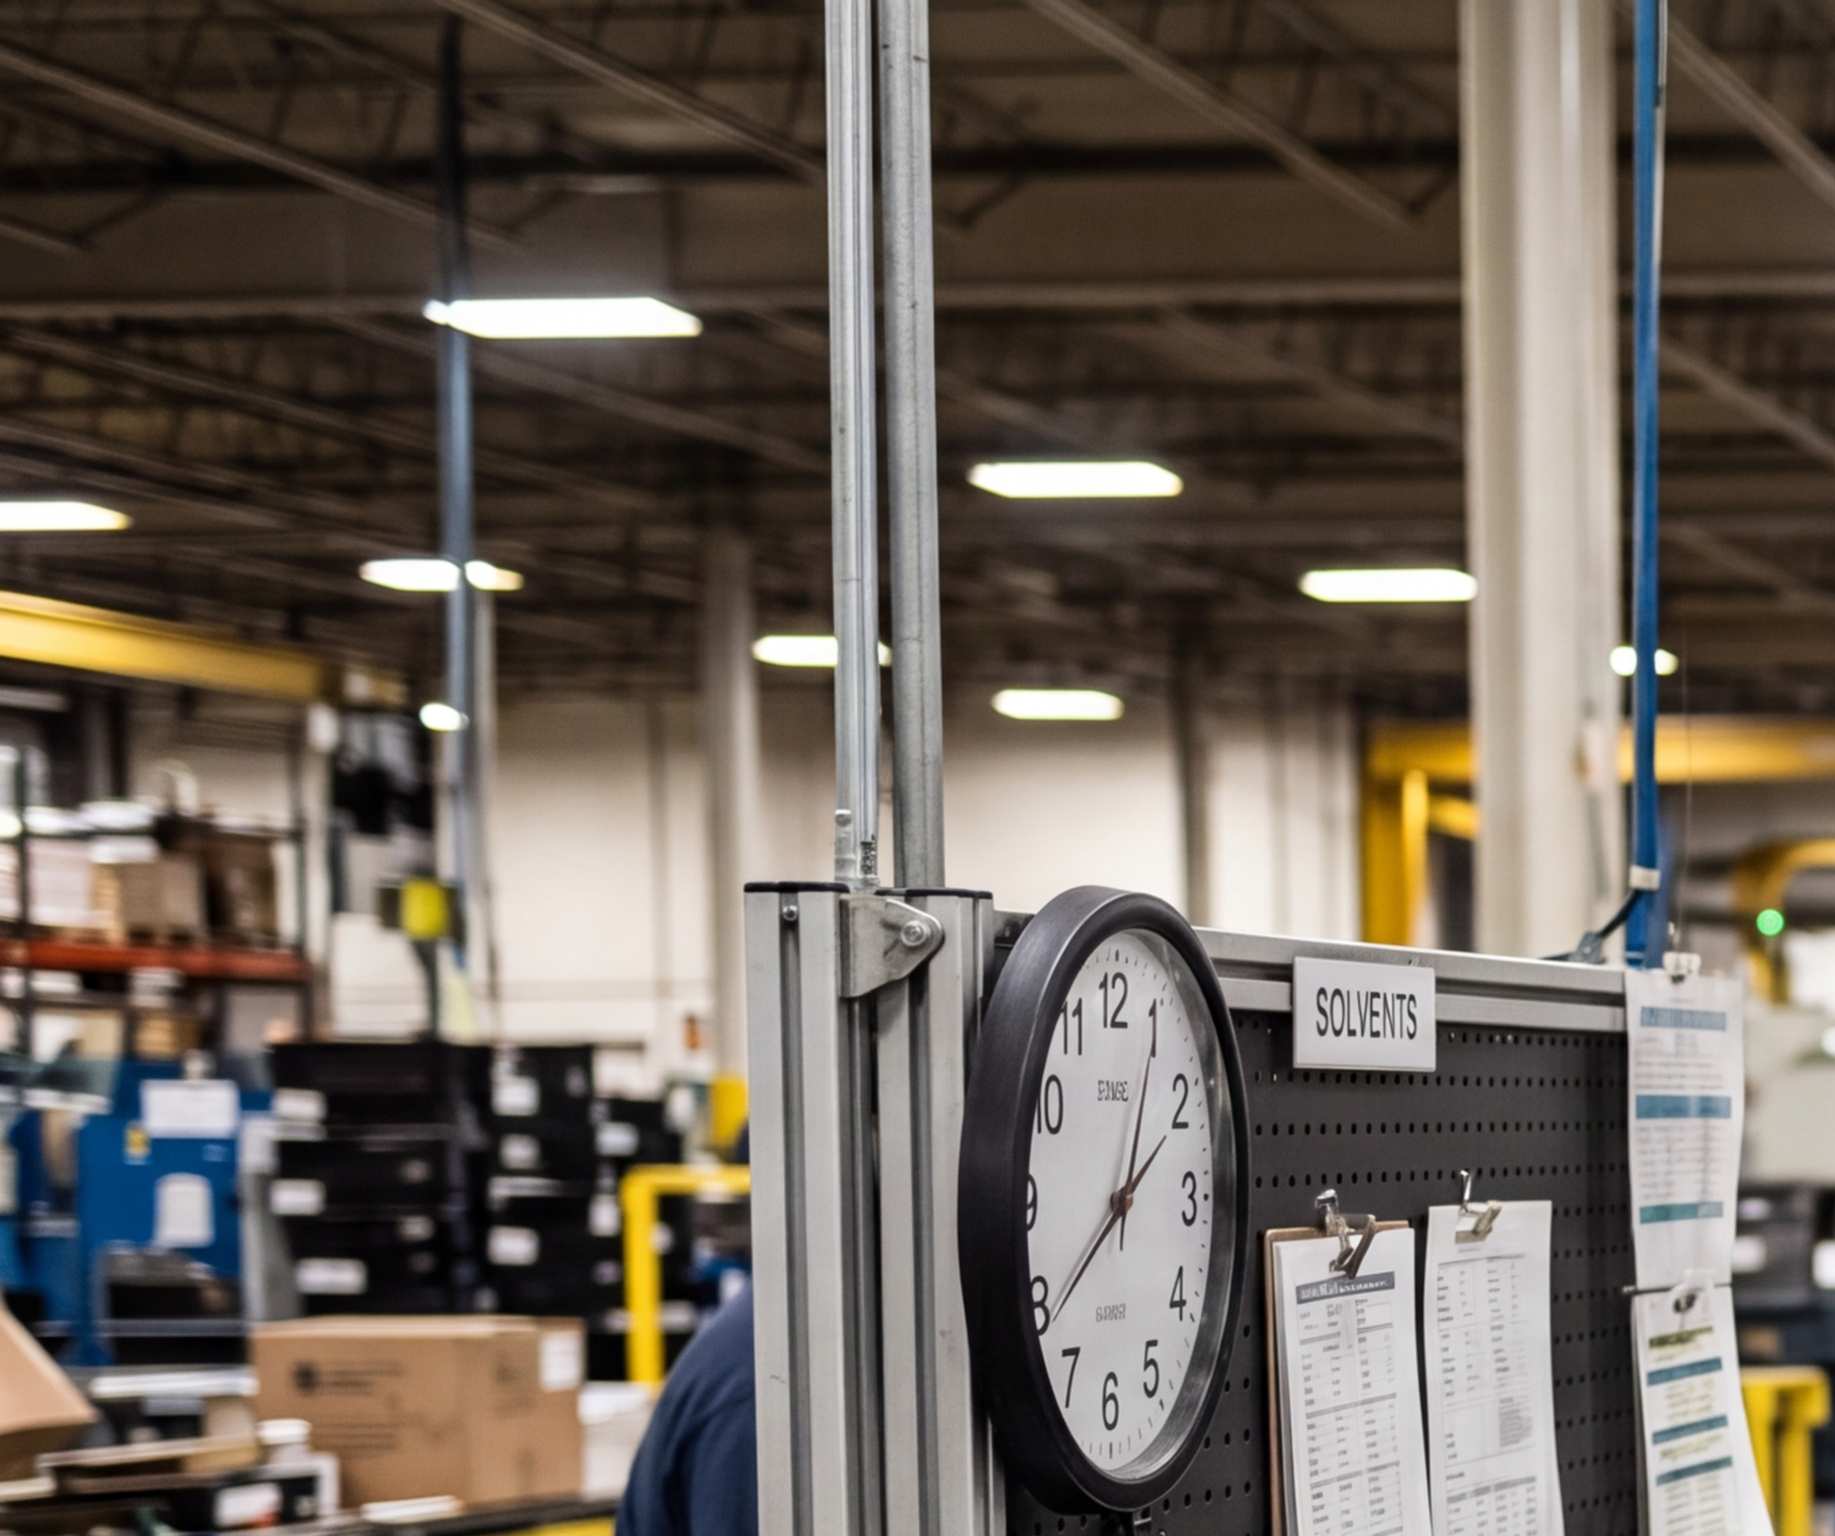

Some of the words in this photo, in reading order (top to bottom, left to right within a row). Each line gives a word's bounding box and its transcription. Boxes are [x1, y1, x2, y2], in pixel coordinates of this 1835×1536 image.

[1060, 997, 1083, 1055] 11
[1099, 971, 1128, 1029] 12
[1149, 998, 1158, 1058] 1
[1316, 986, 1417, 1040] SOLVENTS
[1037, 1074, 1063, 1135] 10
[1171, 1074, 1189, 1130] 2
[1181, 1171, 1198, 1227] 3
[1031, 1275, 1050, 1337] 8
[1169, 1265, 1186, 1322] 4
[1061, 1347, 1081, 1409] 7
[1142, 1339, 1159, 1398] 5
[1102, 1371, 1119, 1431] 6
